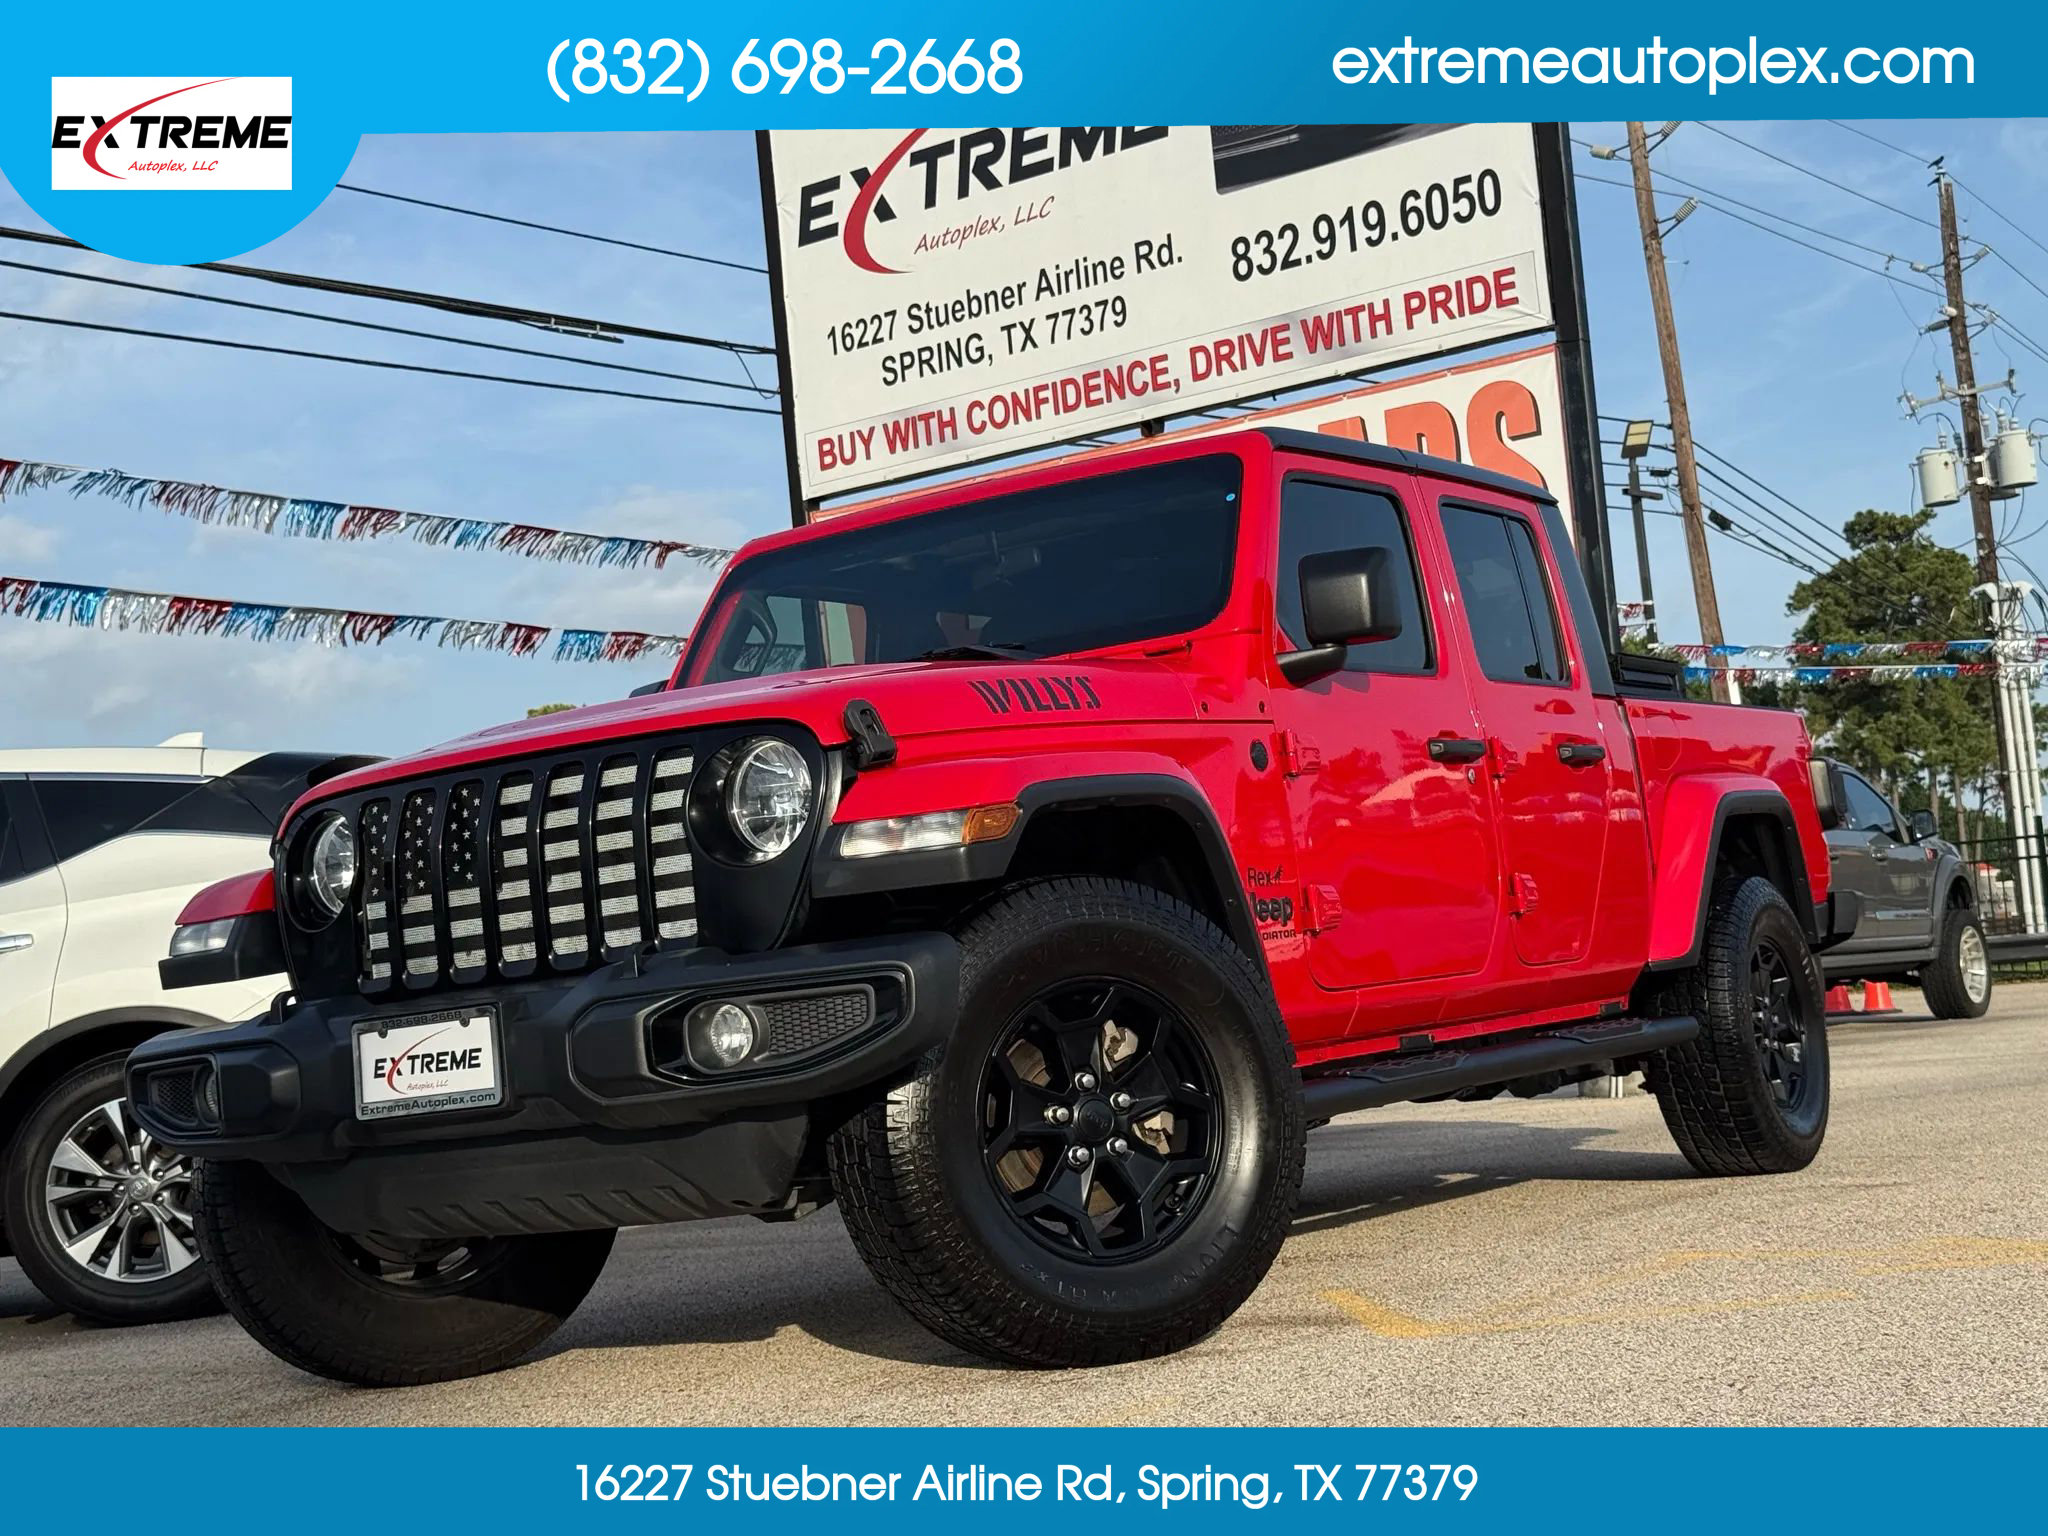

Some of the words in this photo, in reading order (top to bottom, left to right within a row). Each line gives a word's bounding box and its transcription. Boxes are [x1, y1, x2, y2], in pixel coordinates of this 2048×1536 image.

[914, 214, 1005, 255] Autoplex,
[1014, 196, 1055, 226] LLC
[1231, 168, 1502, 283] 832.919.6050
[827, 309, 898, 356] 16227
[907, 289, 1027, 335] Stuebner
[1035, 256, 1125, 302] Airline
[1134, 233, 1183, 275] Rd.
[817, 426, 875, 472] BUY
[882, 406, 958, 455] WITH
[966, 353, 1181, 436] CONFIDENCE,
[1190, 323, 1294, 383] DRIVE
[1301, 298, 1393, 354] WITH
[1403, 266, 1520, 331] PRIDE
[881, 332, 993, 387] SPRING,
[1001, 317, 1039, 356] TX
[1046, 294, 1127, 345] 77379
[967, 676, 1101, 714] WILLYS
[374, 1048, 482, 1079] EXTREME
[361, 1092, 496, 1116] ExtremeAutoplex.com
